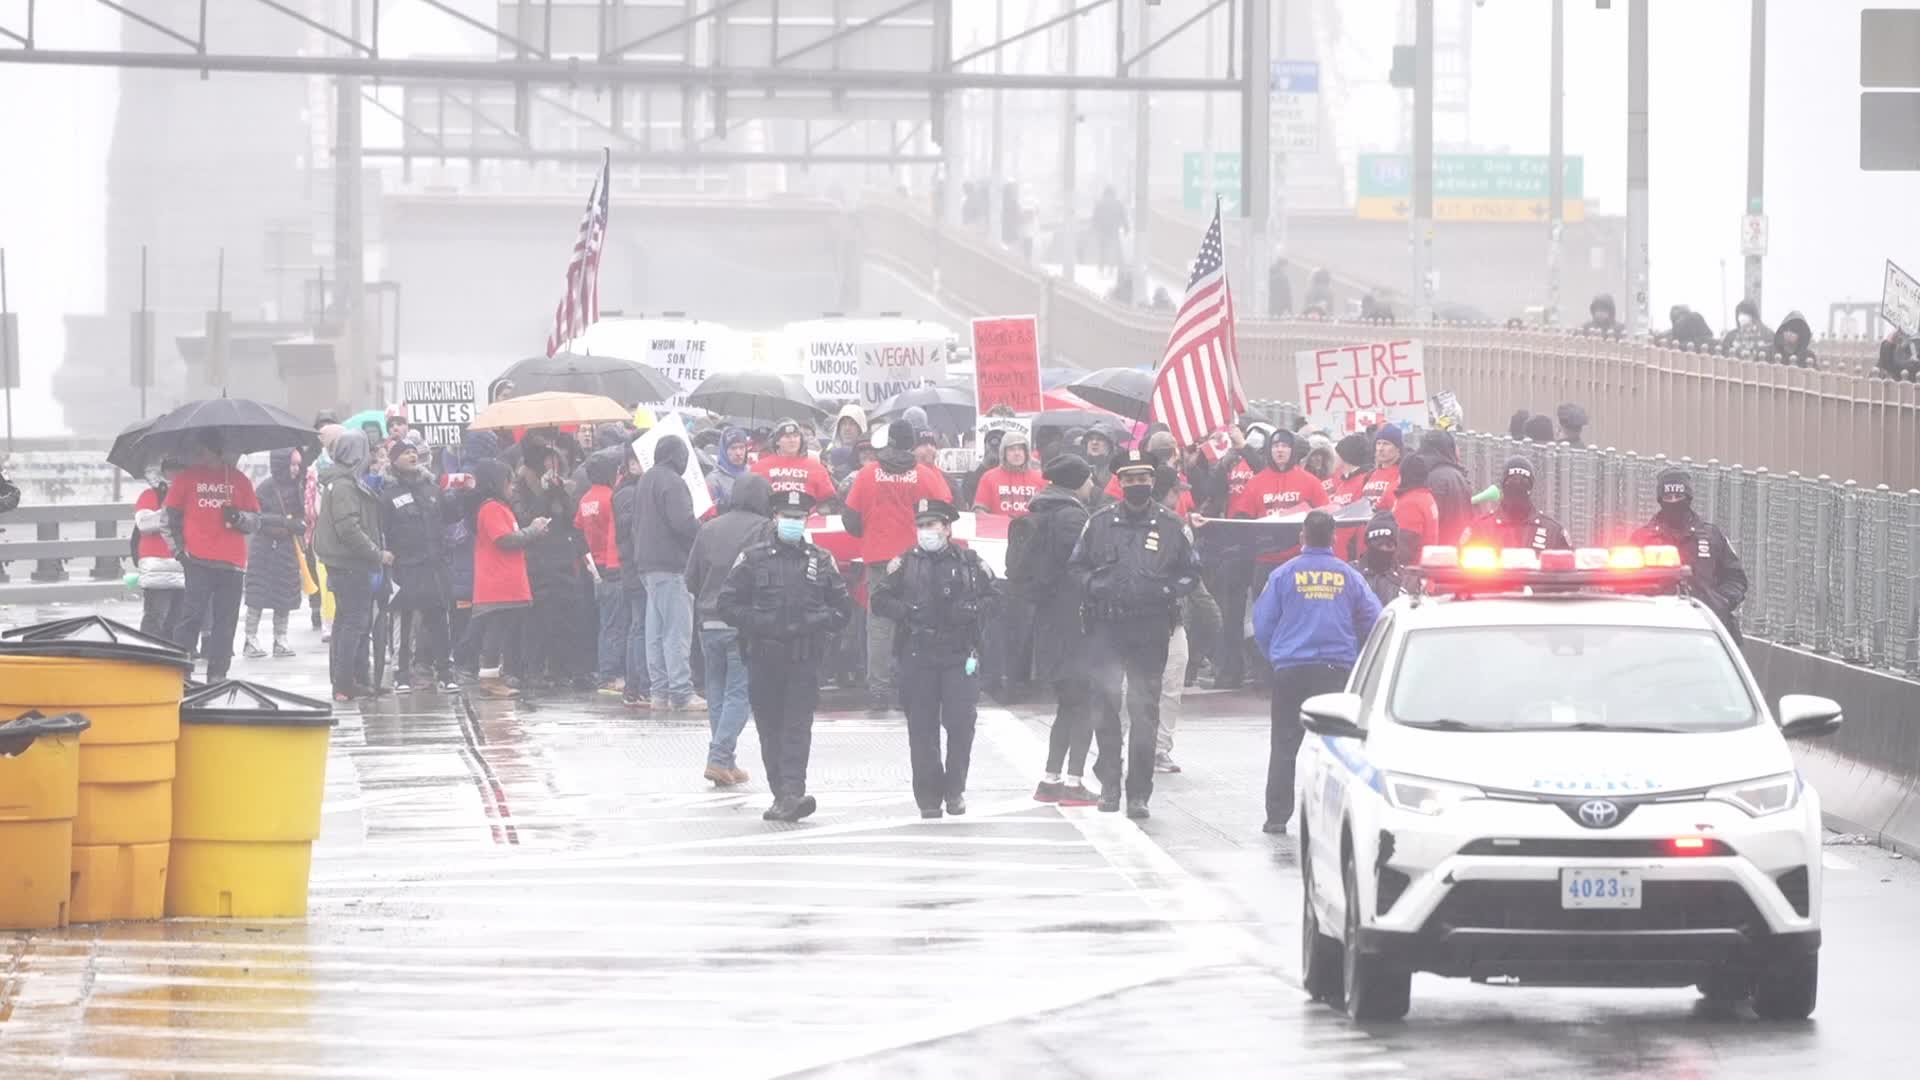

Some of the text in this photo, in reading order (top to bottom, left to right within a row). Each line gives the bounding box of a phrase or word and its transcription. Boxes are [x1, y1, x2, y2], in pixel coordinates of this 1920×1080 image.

[652, 339, 706, 352] WHOM THE
[667, 353, 686, 365] SON
[874, 346, 925, 367] VEGAN
[1315, 340, 1414, 382] FIRE
[810, 359, 858, 375] UNBOUG
[678, 368, 706, 380] FREE
[406, 381, 473, 401] UNVACCINATED
[1303, 372, 1424, 415] FAUCI
[412, 404, 470, 422] LIVES
[424, 425, 461, 445] MATTER
[768, 467, 809, 479] BRAVEST
[1508, 467, 1531, 477] NYPD
[771, 481, 807, 492] CHOICE
[998, 485, 1035, 495] BRAVEST
[1664, 483, 1685, 493] NYPD
[1263, 492, 1300, 504] BRAVEST
[1000, 501, 1028, 511] CHOIC
[1368, 528, 1392, 538] NYPD
[1295, 571, 1345, 585] NYPD
[1569, 878, 1635, 897] 4023 17
